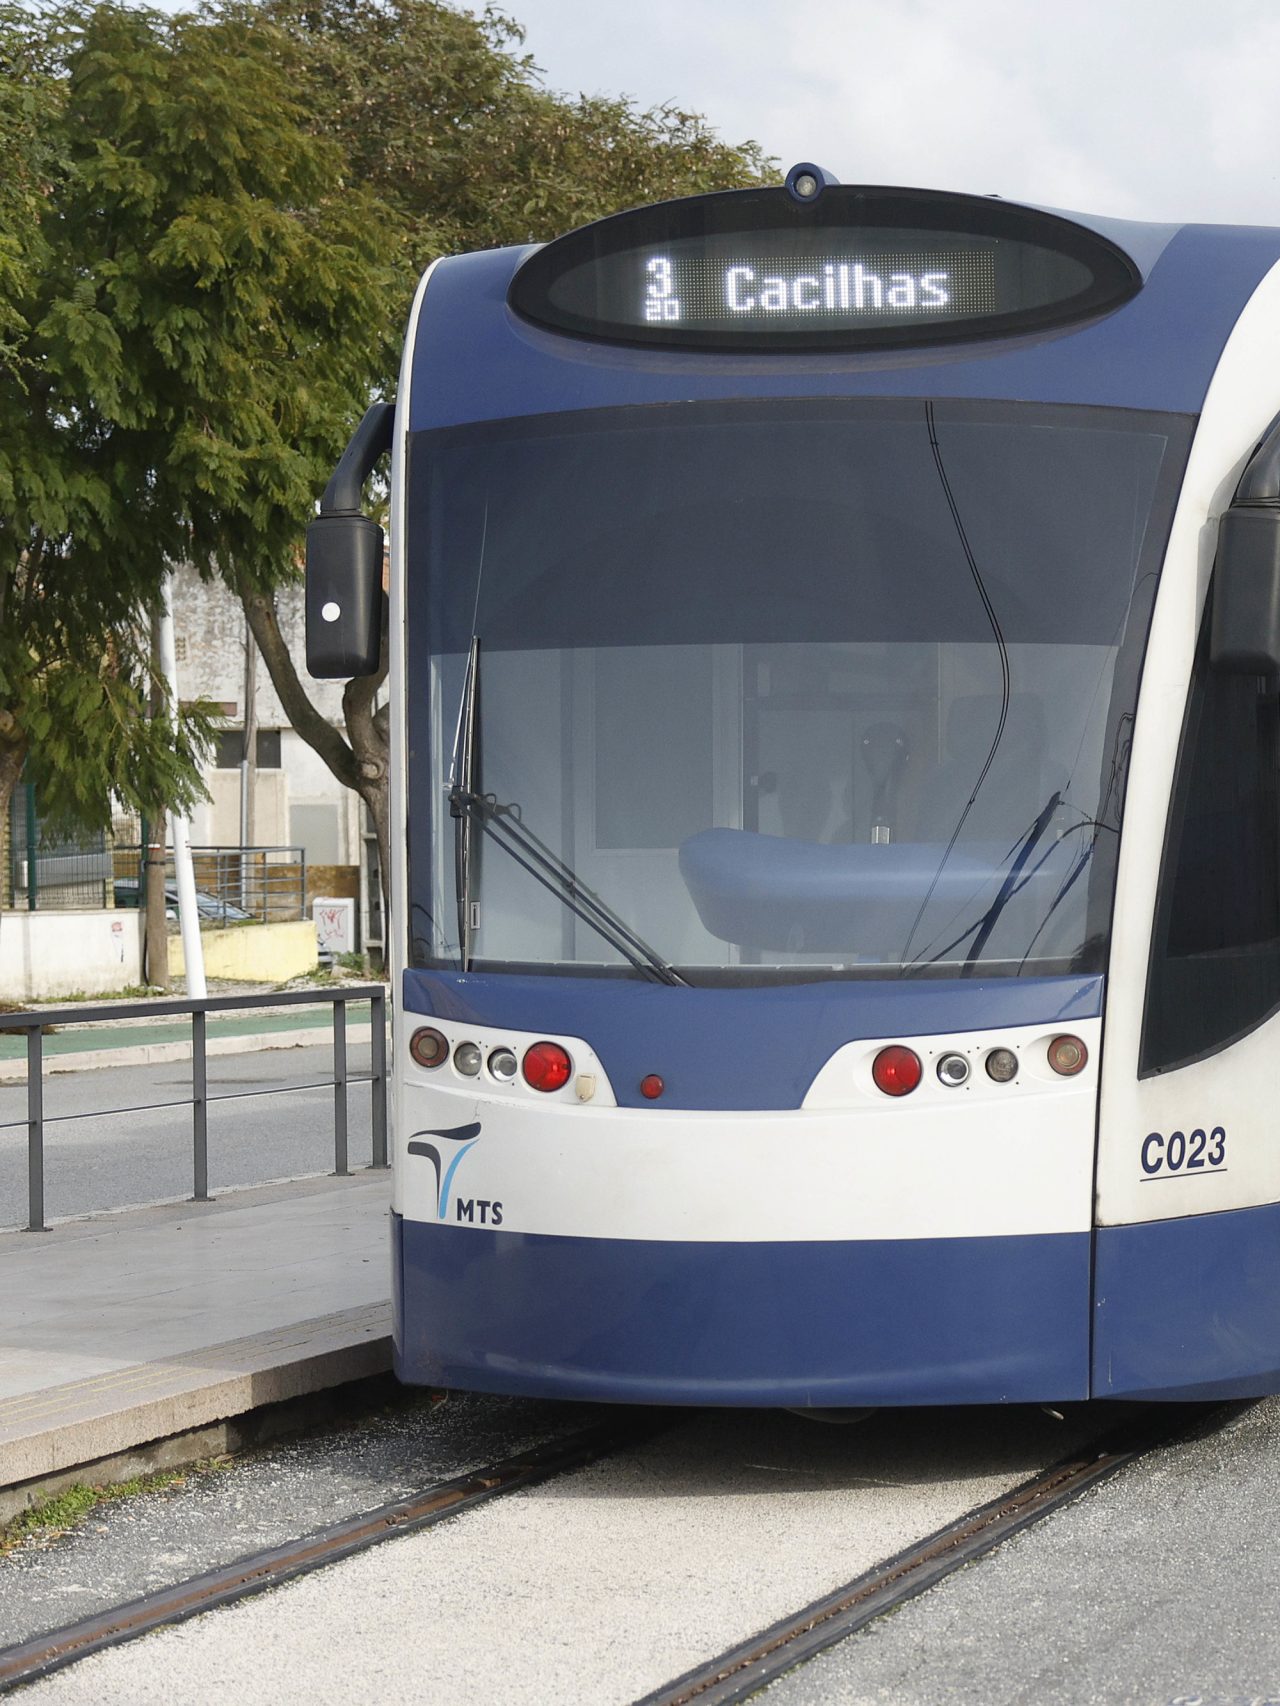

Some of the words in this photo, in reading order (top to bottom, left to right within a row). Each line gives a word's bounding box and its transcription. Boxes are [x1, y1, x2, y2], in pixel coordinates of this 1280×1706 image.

[647, 257, 672, 298] 3
[727, 263, 949, 311] Cacilhas
[1140, 1125, 1226, 1174] C023
[456, 1197, 503, 1226] MTS
